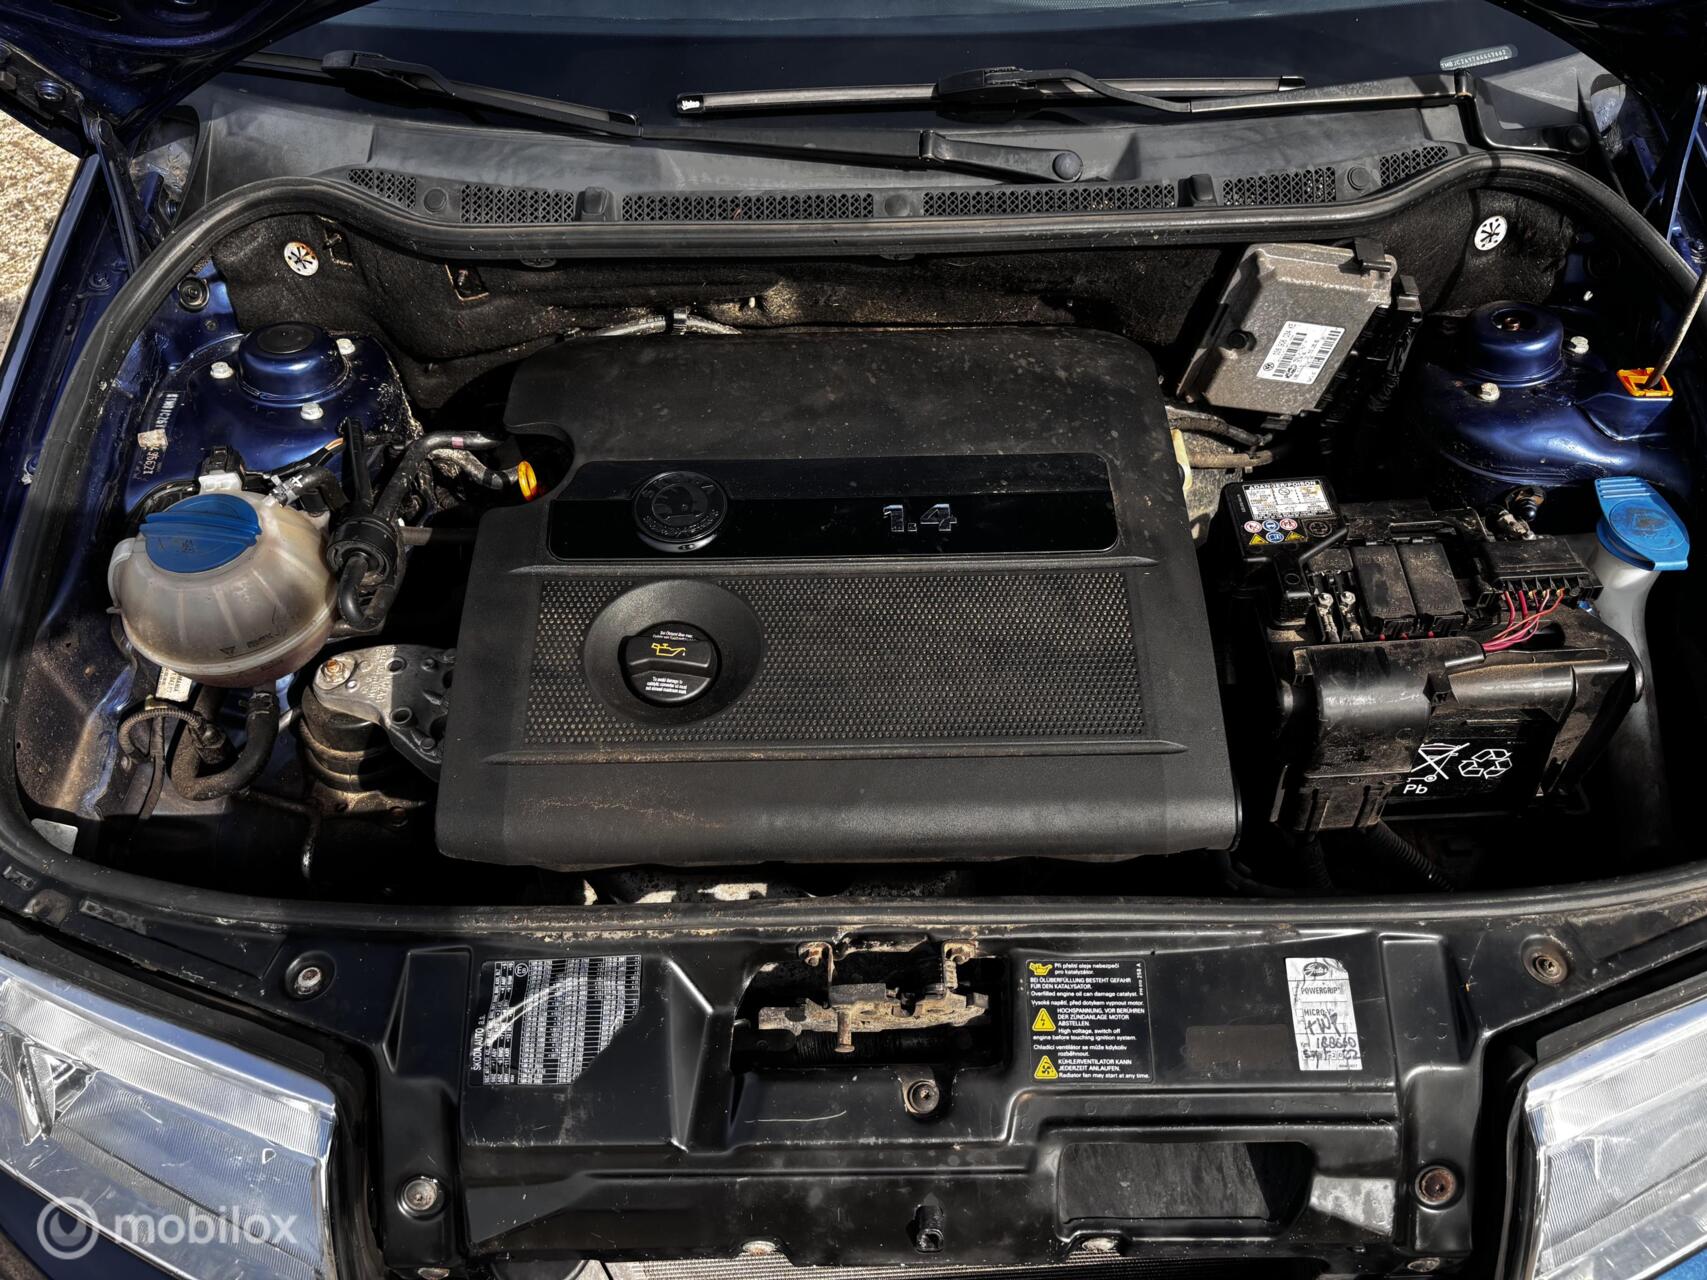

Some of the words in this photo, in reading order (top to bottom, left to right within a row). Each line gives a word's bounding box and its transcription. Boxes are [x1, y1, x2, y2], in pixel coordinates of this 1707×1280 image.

[883, 504, 957, 532] 1.4
[1403, 784, 1428, 794] Pb
[475, 1028, 484, 1046] AUTO
[471, 1048, 482, 1071] ŠKODA
